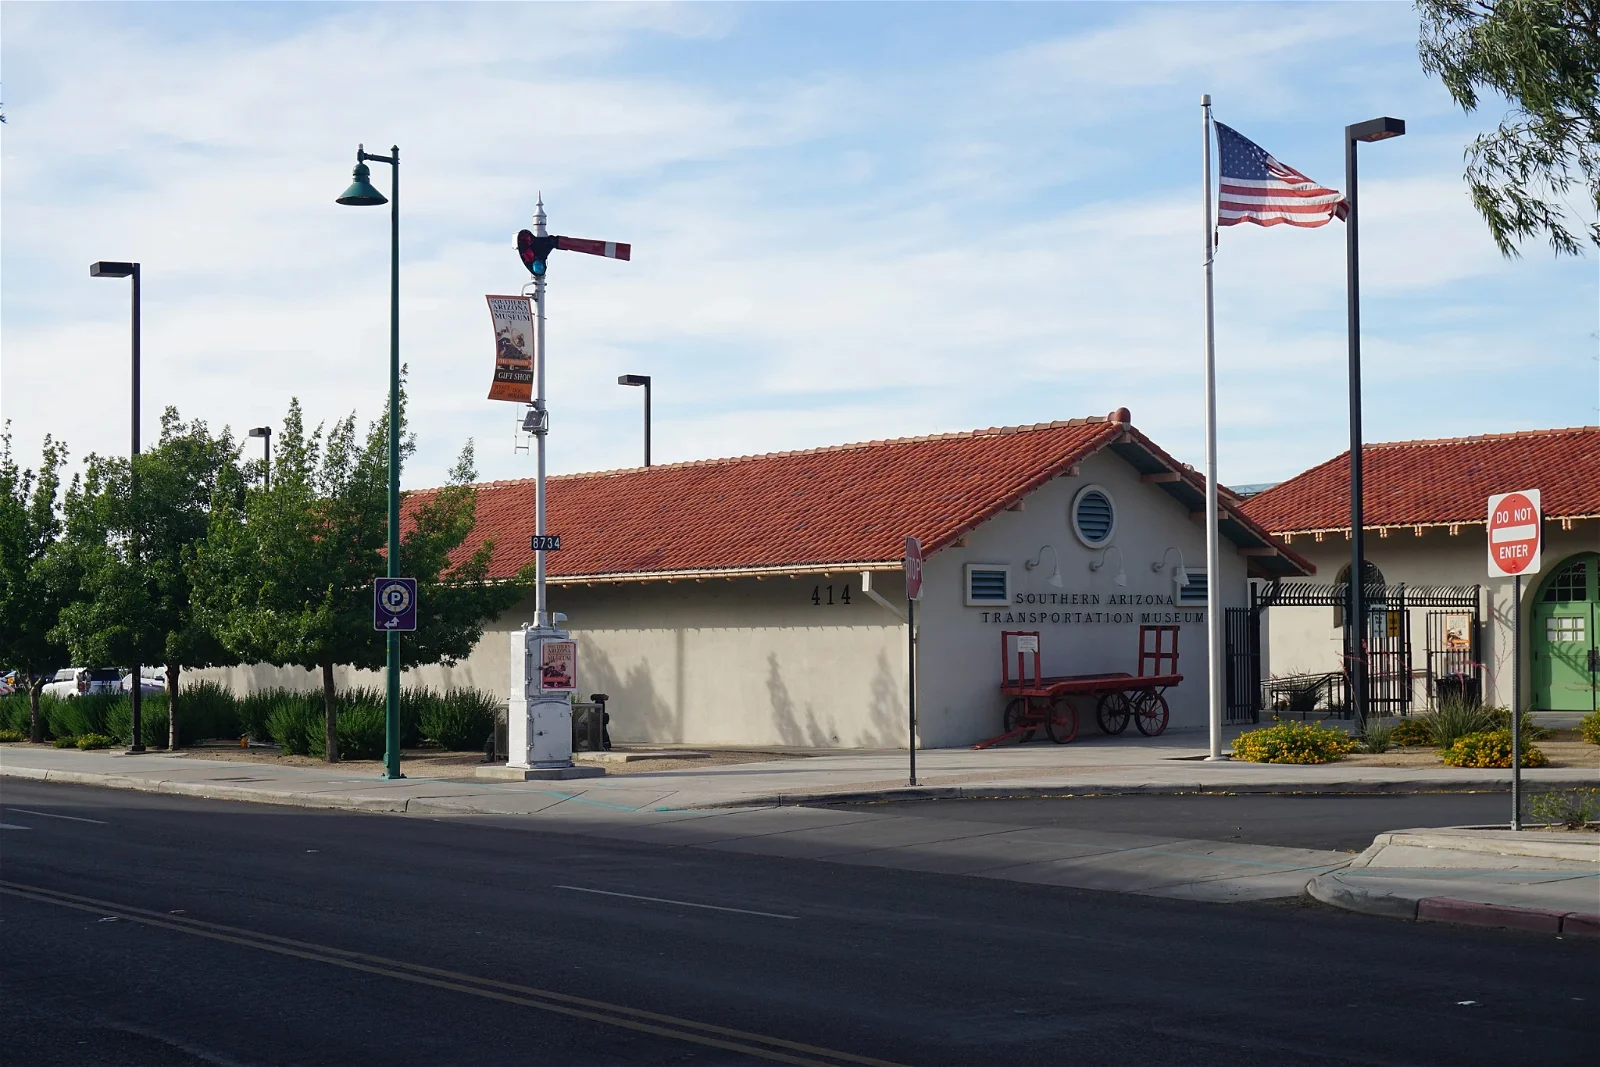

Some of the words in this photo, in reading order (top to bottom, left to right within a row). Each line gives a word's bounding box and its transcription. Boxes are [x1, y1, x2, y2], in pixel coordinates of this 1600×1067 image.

[493, 304, 529, 312] ARIZONA
[495, 313, 530, 322] MUSEUM
[498, 372, 513, 380] GIFT
[514, 373, 531, 381] SHOP
[1496, 511, 1509, 524] DO
[1514, 507, 1532, 522] NOT
[533, 537, 560, 549] 8734
[1500, 544, 1528, 560] ENTER
[906, 556, 921, 580] STOP
[391, 592, 401, 605] P
[811, 584, 851, 606] 414
[1016, 593, 1100, 605] SOUTHERN
[1109, 594, 1174, 605] ARIZONA
[982, 612, 1134, 623] TRANSPORTATION
[1141, 612, 1204, 623] MUSEUM
